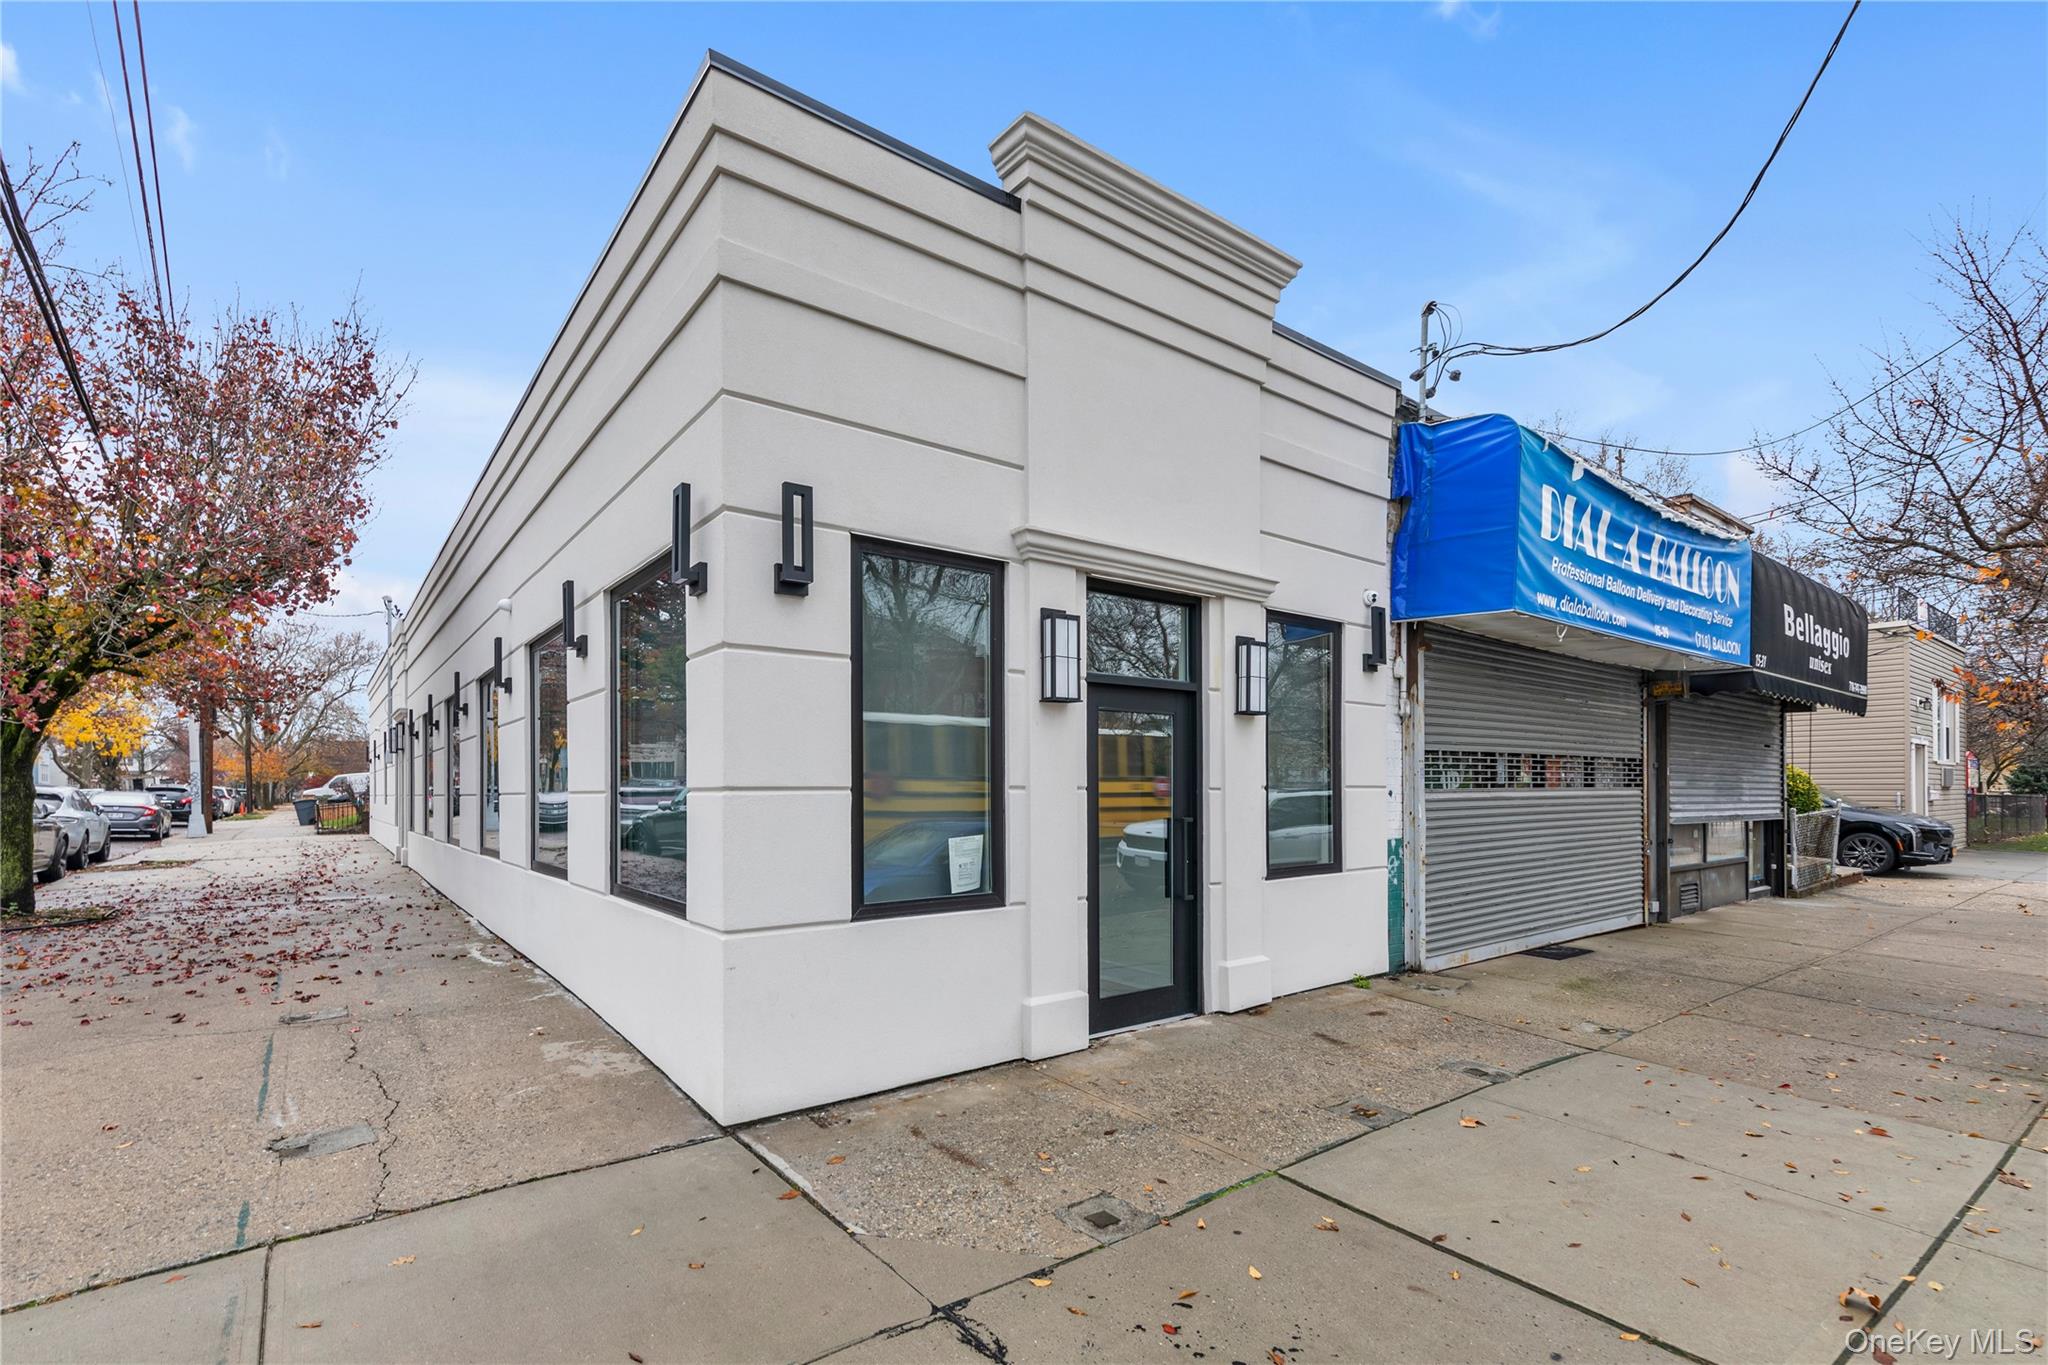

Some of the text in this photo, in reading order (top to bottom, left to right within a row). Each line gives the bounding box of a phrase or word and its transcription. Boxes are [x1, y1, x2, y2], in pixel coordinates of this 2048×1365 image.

[1541, 484, 1740, 608] DIAL-A-BALLOON
[1536, 592, 1627, 628] www.dialaballoon.com
[1552, 556, 1734, 627] Professional Balloon Delivery and Decorating Service
[1712, 637, 1741, 655] BALLOON
[1783, 603, 1850, 659] Bellaggio
[1808, 655, 1832, 675] unisex
